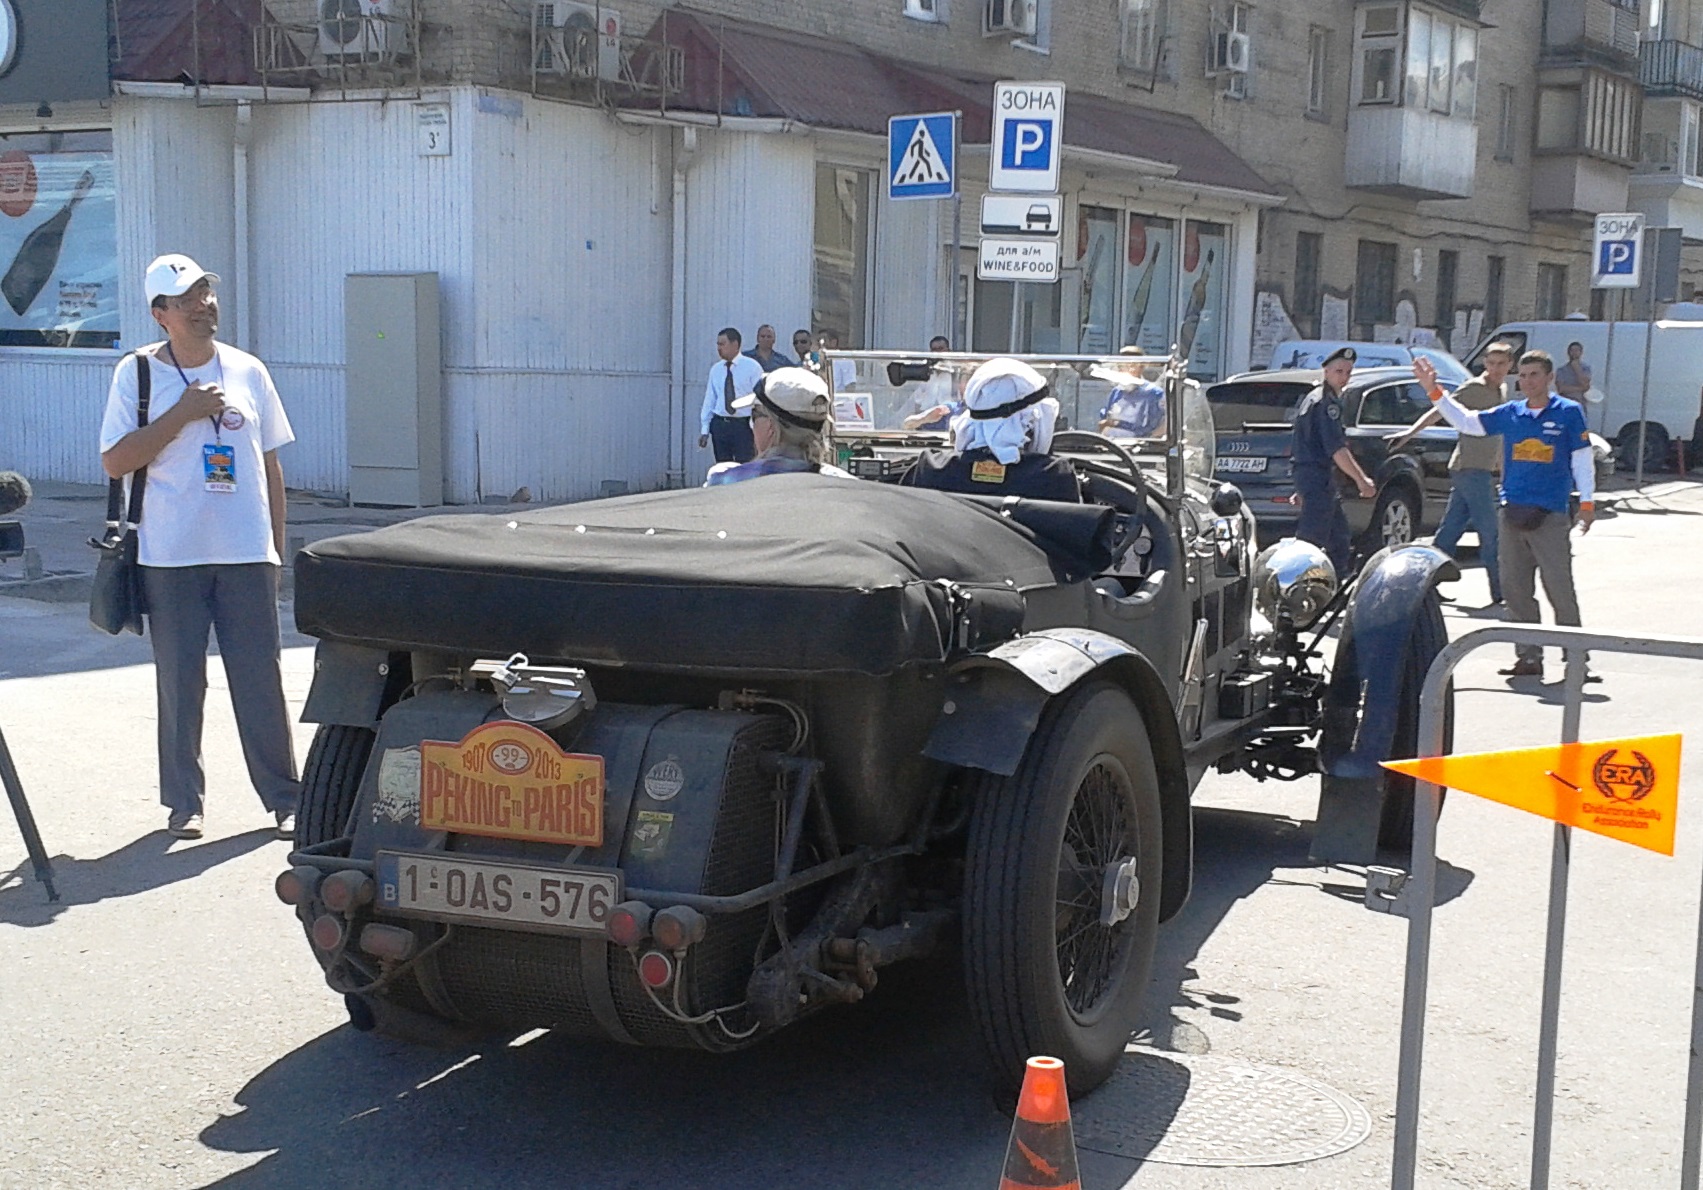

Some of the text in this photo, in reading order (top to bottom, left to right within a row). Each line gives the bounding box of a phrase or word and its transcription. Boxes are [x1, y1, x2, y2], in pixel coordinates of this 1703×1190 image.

[1001, 90, 1056, 110] ЗОНА
[1015, 123, 1044, 166] P
[1599, 220, 1638, 235] ЗОНА
[996, 247, 1017, 256] для
[1608, 243, 1630, 272] P
[983, 259, 1054, 273] WINE&FOOD
[462, 742, 486, 774] 1907
[534, 747, 561, 780] 2013
[1601, 764, 1646, 786] ERA
[426, 760, 511, 828] PEKING
[511, 800, 522, 817] TO
[523, 776, 599, 837] PARIS
[384, 883, 396, 901] B
